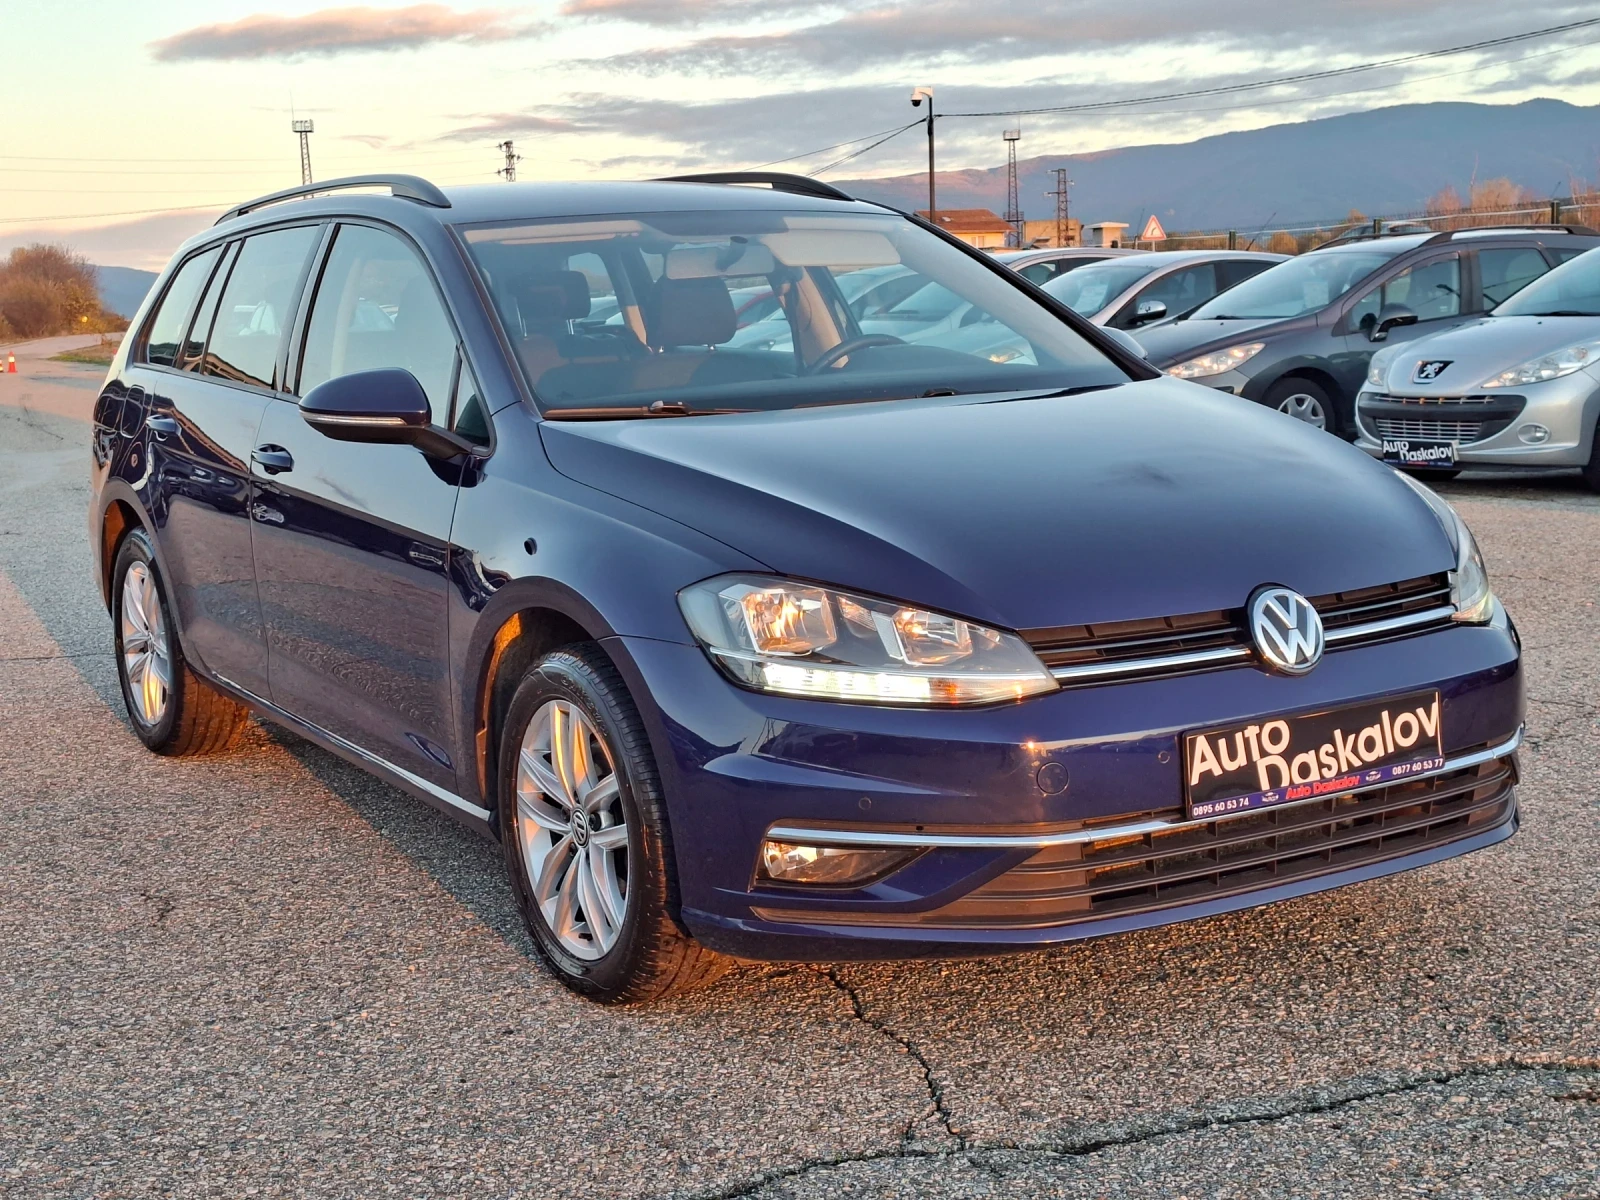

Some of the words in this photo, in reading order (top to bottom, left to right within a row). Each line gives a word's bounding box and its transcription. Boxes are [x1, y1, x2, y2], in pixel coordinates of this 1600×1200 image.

[1383, 440, 1410, 454] Auto
[1253, 588, 1324, 671] VW
[1190, 720, 1291, 786] Auto
[1255, 700, 1439, 791] Daskalov
[1193, 804, 1213, 816] 0895
[1214, 802, 1225, 812] 60
[1227, 800, 1237, 810] 53
[1239, 797, 1249, 807] 74
[1285, 785, 1312, 800] Auto
[1313, 776, 1360, 795] Daskalov
[1392, 764, 1411, 775] 0877
[1412, 762, 1421, 771] 60
[1423, 760, 1433, 769] 53
[1434, 758, 1444, 767] 77
